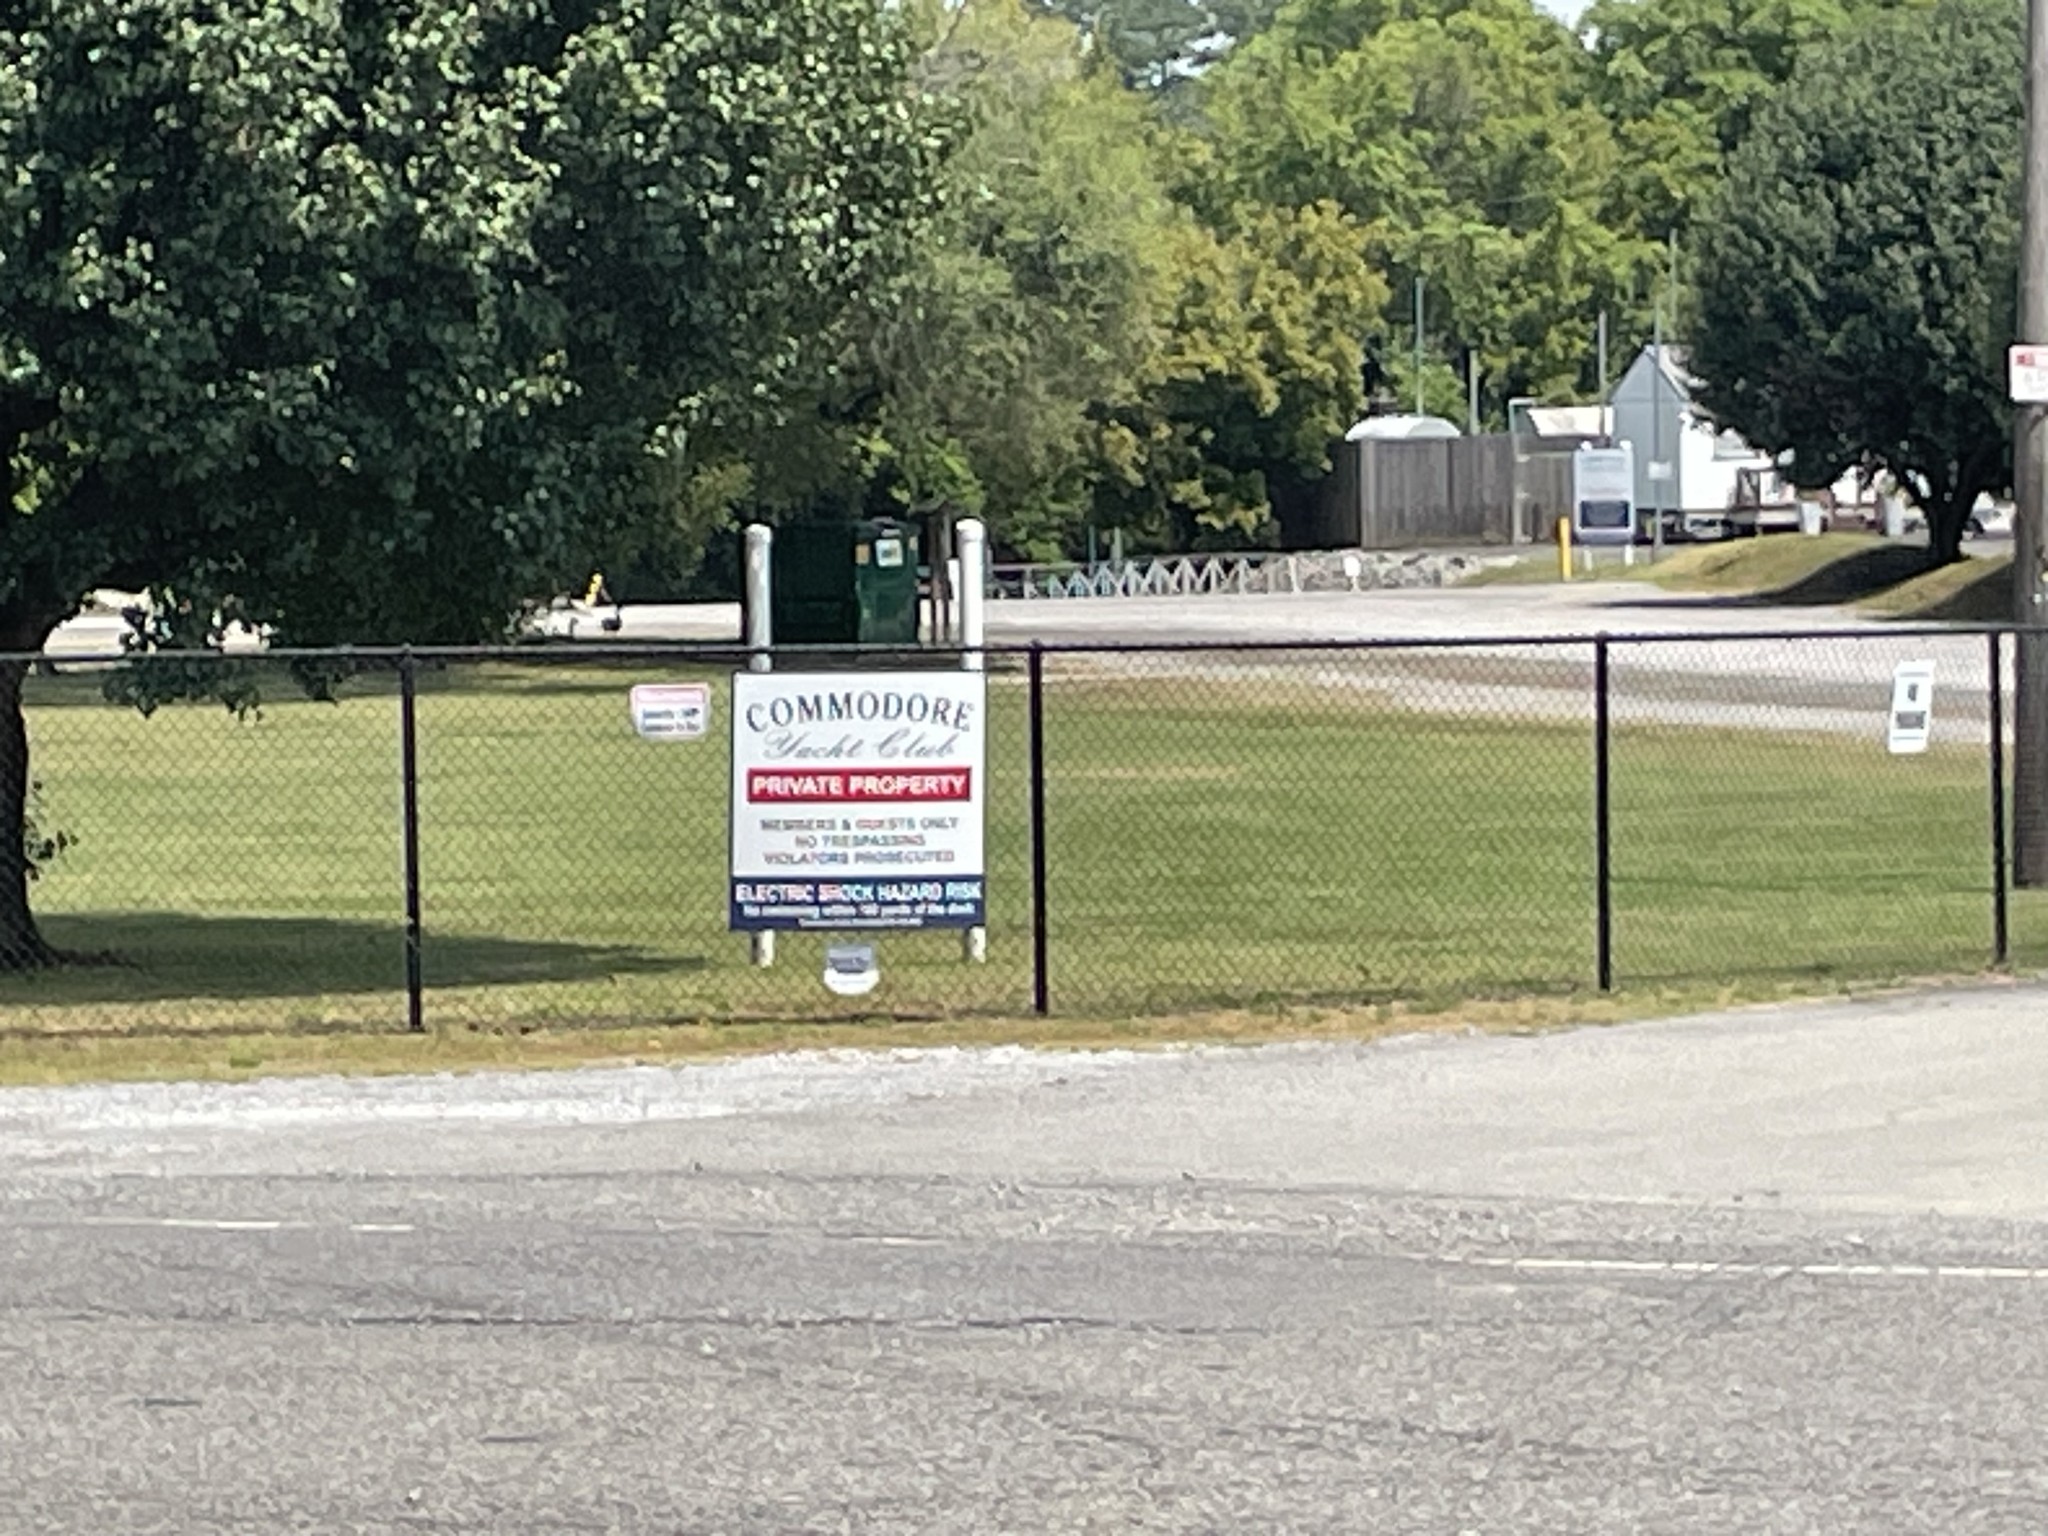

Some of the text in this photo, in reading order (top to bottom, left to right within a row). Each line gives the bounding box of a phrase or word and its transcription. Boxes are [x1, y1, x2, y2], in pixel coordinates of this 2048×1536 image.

[747, 691, 974, 732] COMMODORE
[763, 727, 960, 759] Yacht Club
[753, 774, 966, 795] PRIVATE PROPERTY
[920, 816, 958, 830] ONLY
[795, 834, 926, 848] NO TRESPASSING
[763, 850, 955, 865] VIOLATORS PROSECUTED
[735, 881, 981, 903] ELECTRIC SHOCK HAZARD RISK
